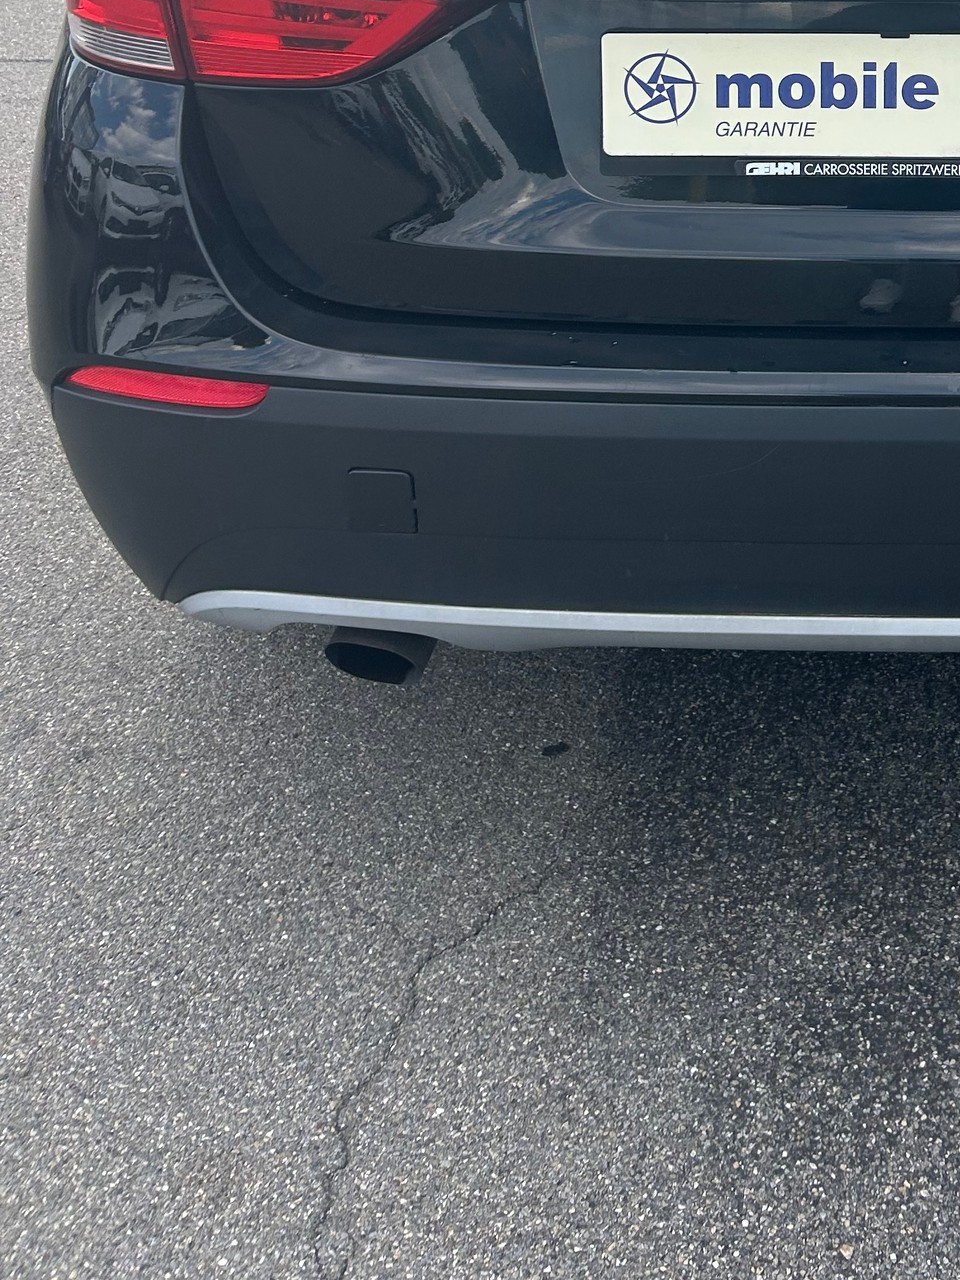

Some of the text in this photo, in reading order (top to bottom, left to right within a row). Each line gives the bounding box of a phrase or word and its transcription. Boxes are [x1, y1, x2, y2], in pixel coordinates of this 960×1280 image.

[715, 61, 940, 110] mobile
[715, 121, 817, 137] GARANTIE
[745, 162, 800, 176] GEHRI
[804, 163, 888, 176] CARROSSERIE
